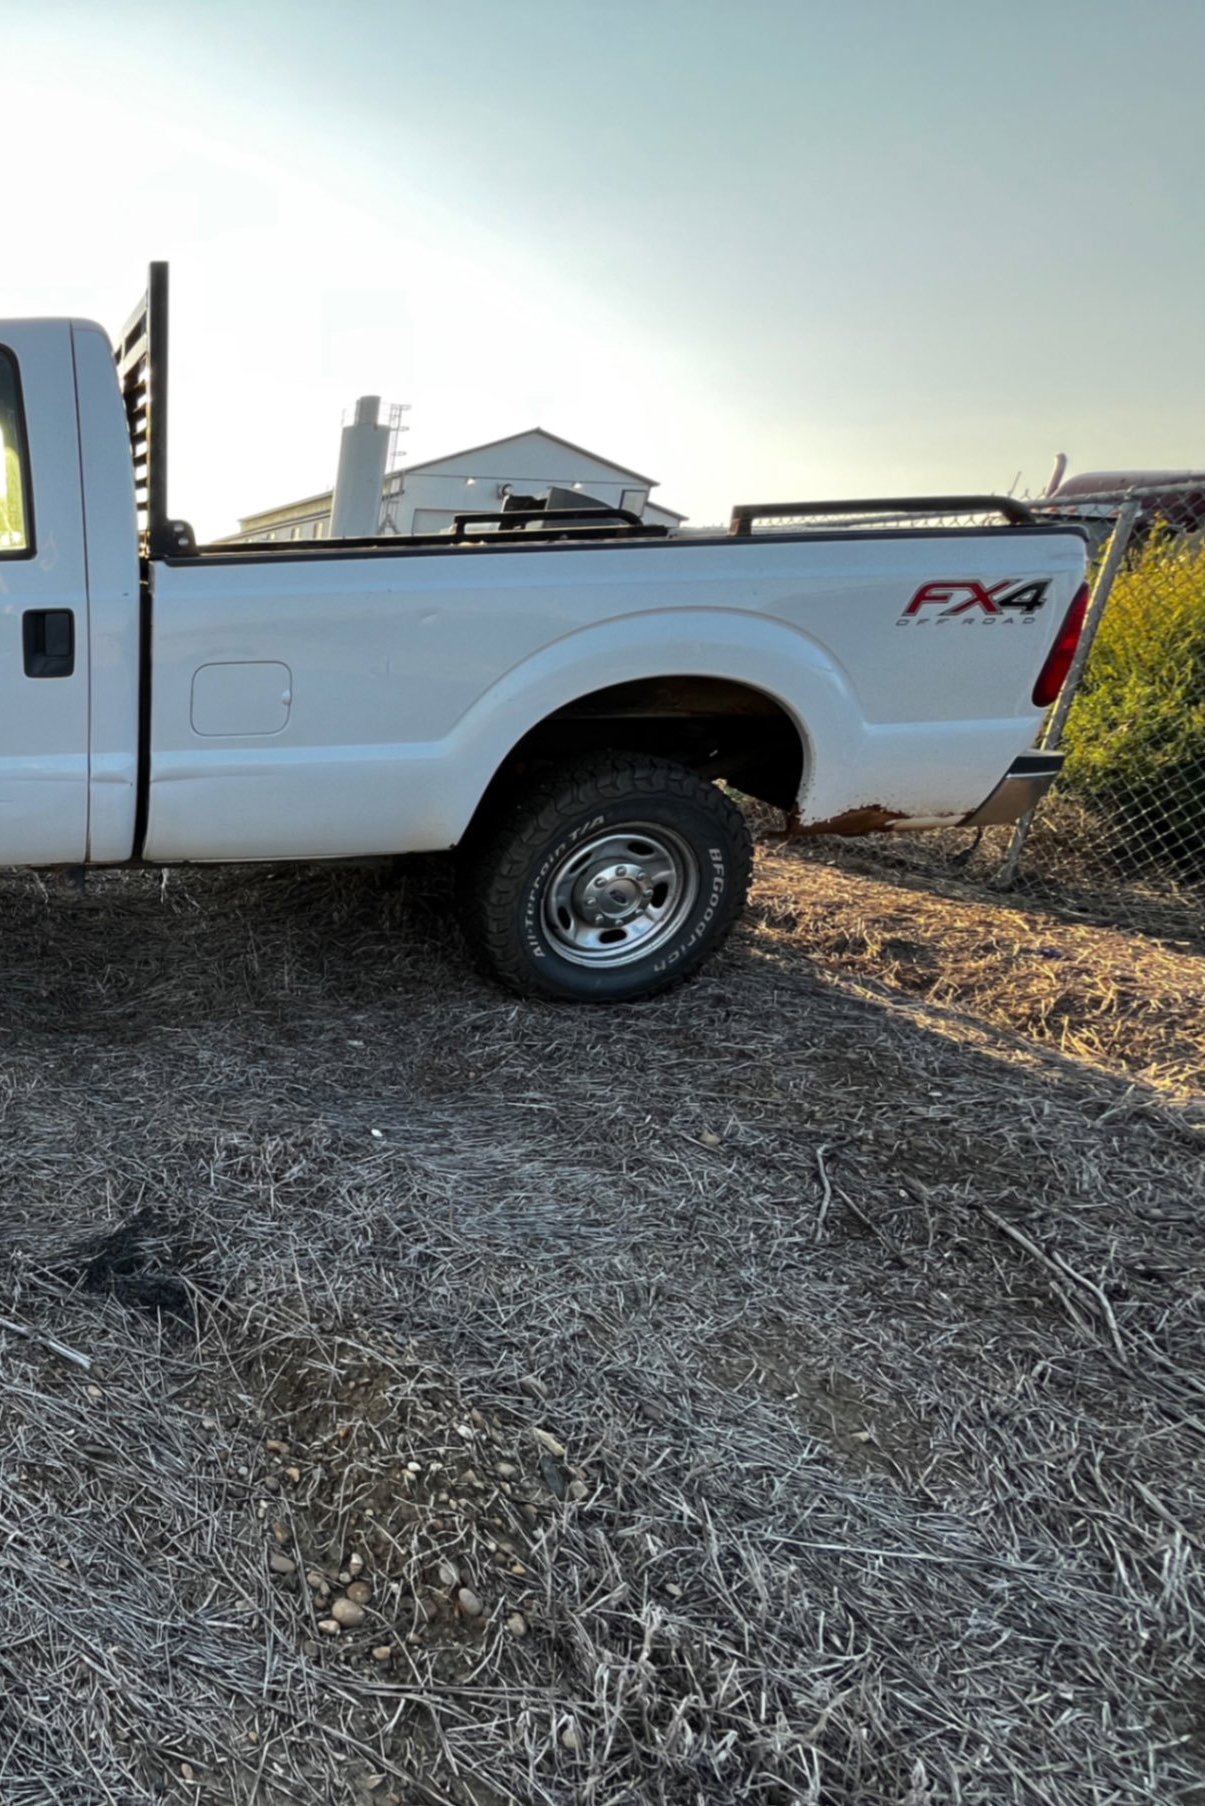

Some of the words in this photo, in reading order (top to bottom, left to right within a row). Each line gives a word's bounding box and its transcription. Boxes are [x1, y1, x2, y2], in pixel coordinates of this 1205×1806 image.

[895, 618, 950, 626] OFF
[961, 617, 1035, 625] ROAD
[901, 578, 1053, 616] FX4
[524, 842, 566, 958] All-Terrain
[569, 815, 605, 841] T/A
[653, 848, 724, 973] BFGoodrich
